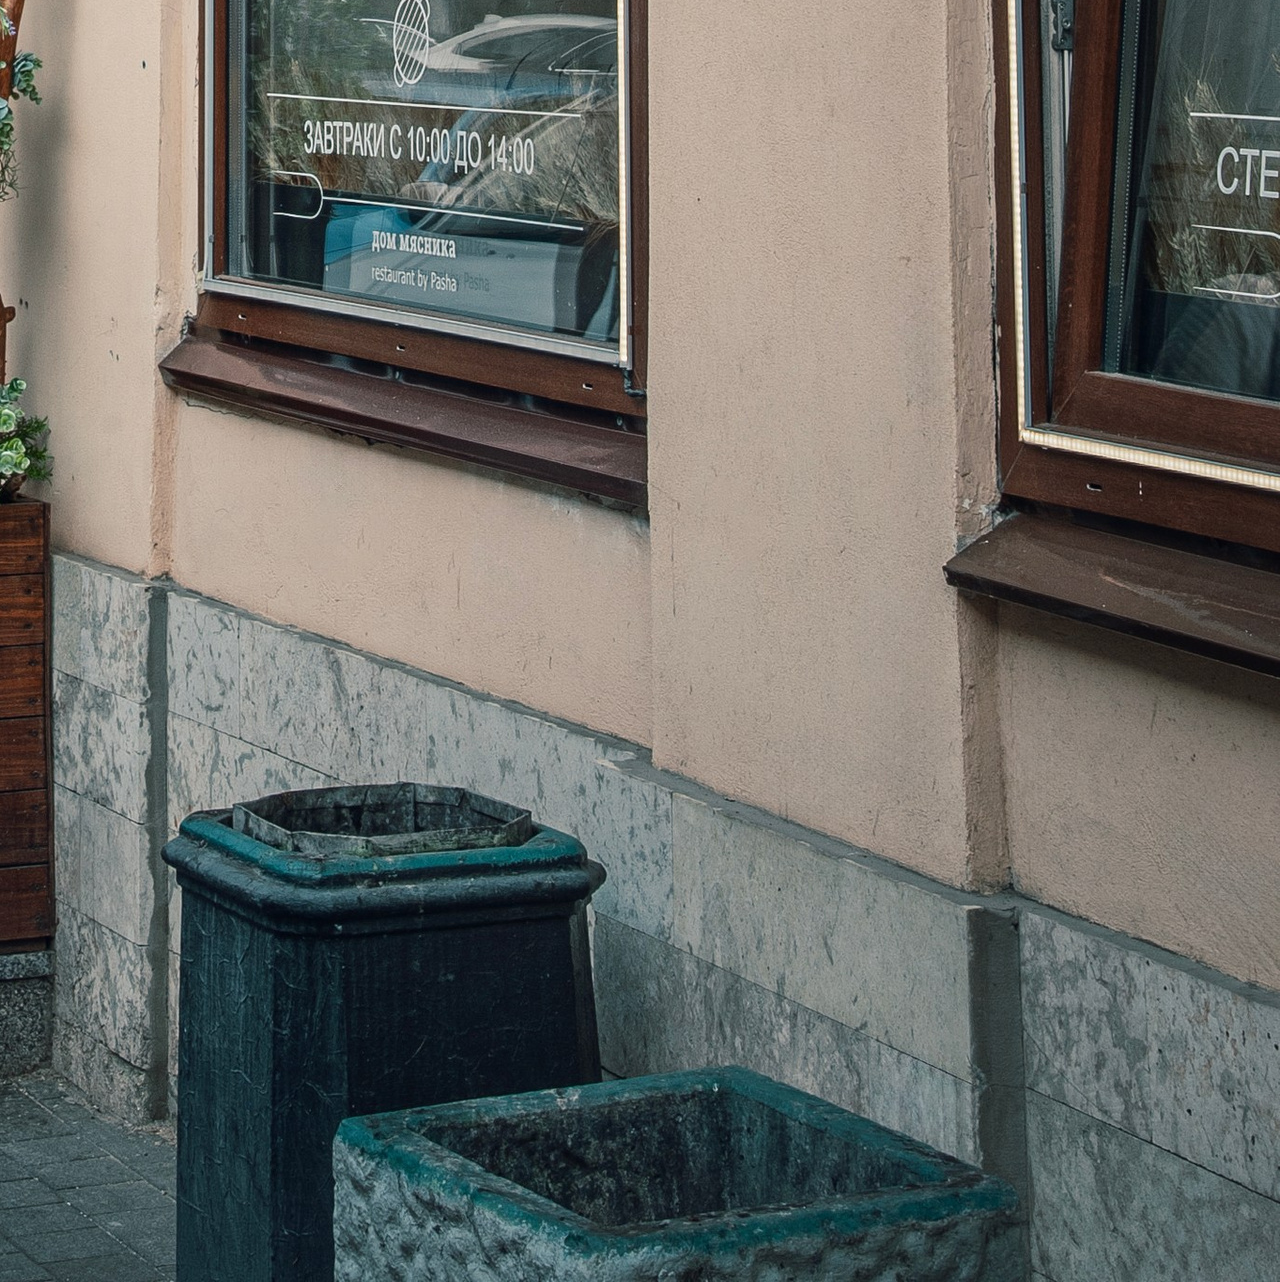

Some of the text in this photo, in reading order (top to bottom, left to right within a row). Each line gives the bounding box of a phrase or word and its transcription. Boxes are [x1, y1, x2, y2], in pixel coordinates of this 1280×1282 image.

[303, 119, 535, 176] ЗАВТРАКИ С 10:00 ДО 14:00
[371, 265, 457, 292] restaurant by Pasha
